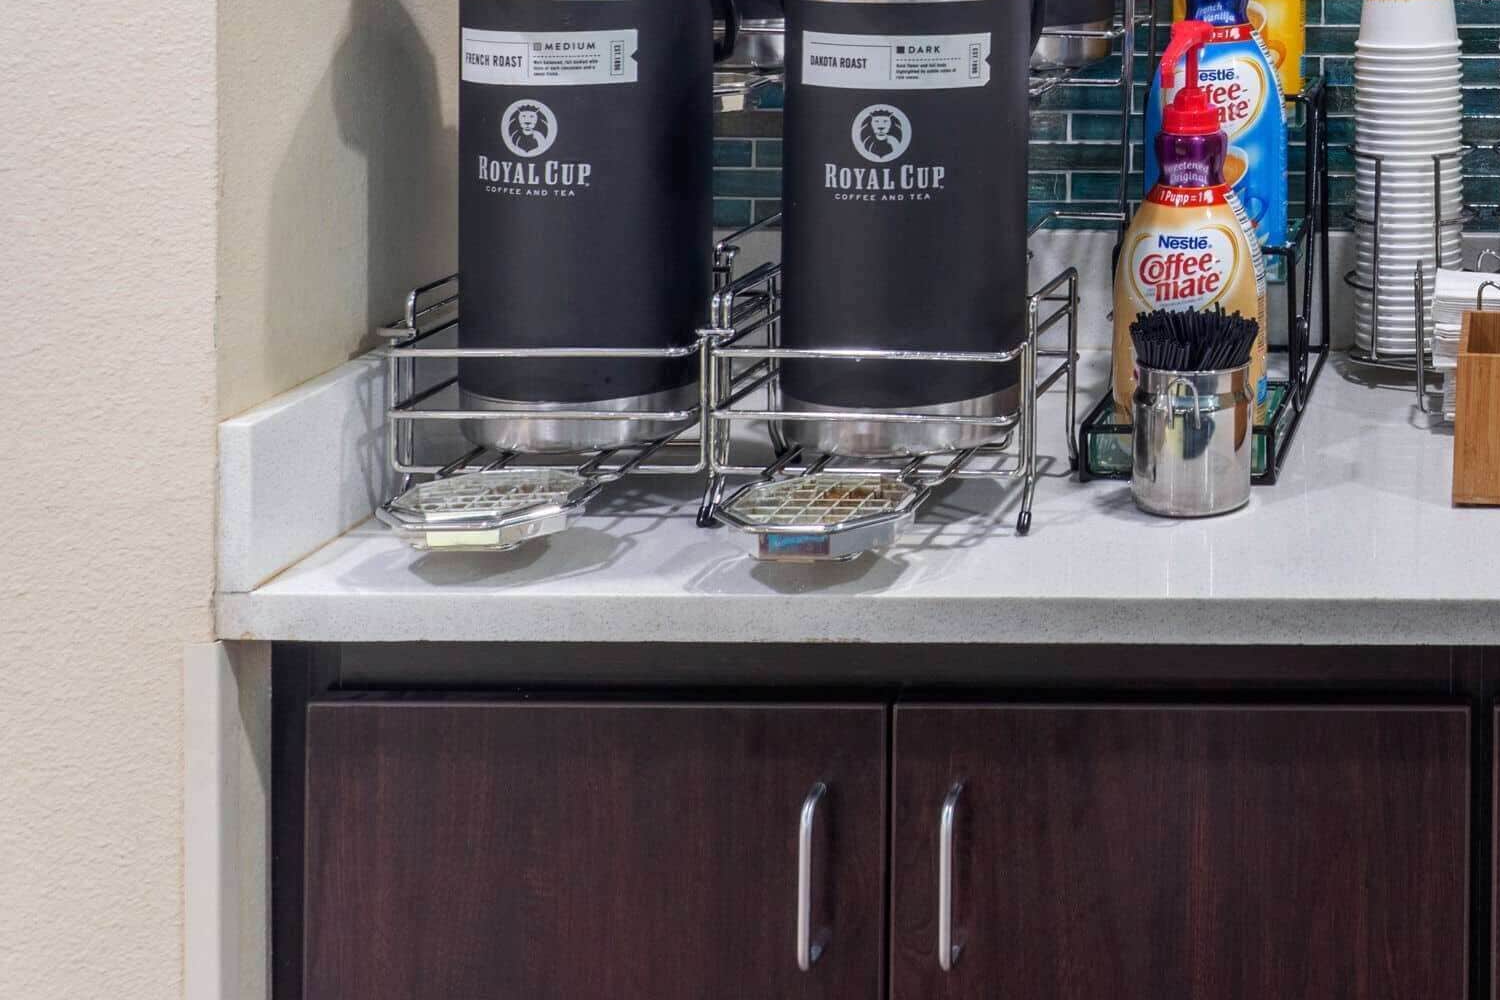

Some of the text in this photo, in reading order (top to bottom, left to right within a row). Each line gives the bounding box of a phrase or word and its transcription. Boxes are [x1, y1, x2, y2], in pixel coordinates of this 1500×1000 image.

[544, 42, 596, 51] MEDIUM
[908, 46, 940, 54] DARK
[465, 52, 490, 66] FRENCH
[493, 55, 523, 68] ROAST
[810, 55, 867, 69] DAKOTA ROAST
[1200, 67, 1235, 81] estlé
[1217, 99, 1249, 123] ate
[479, 155, 591, 187] ROYAL CUP
[824, 163, 945, 190] ROYAL CUP
[485, 185, 575, 197] COFFEE AND TEA
[835, 193, 876, 201] COFFEE
[881, 193, 904, 201] AND
[1155, 272, 1220, 302] mate
